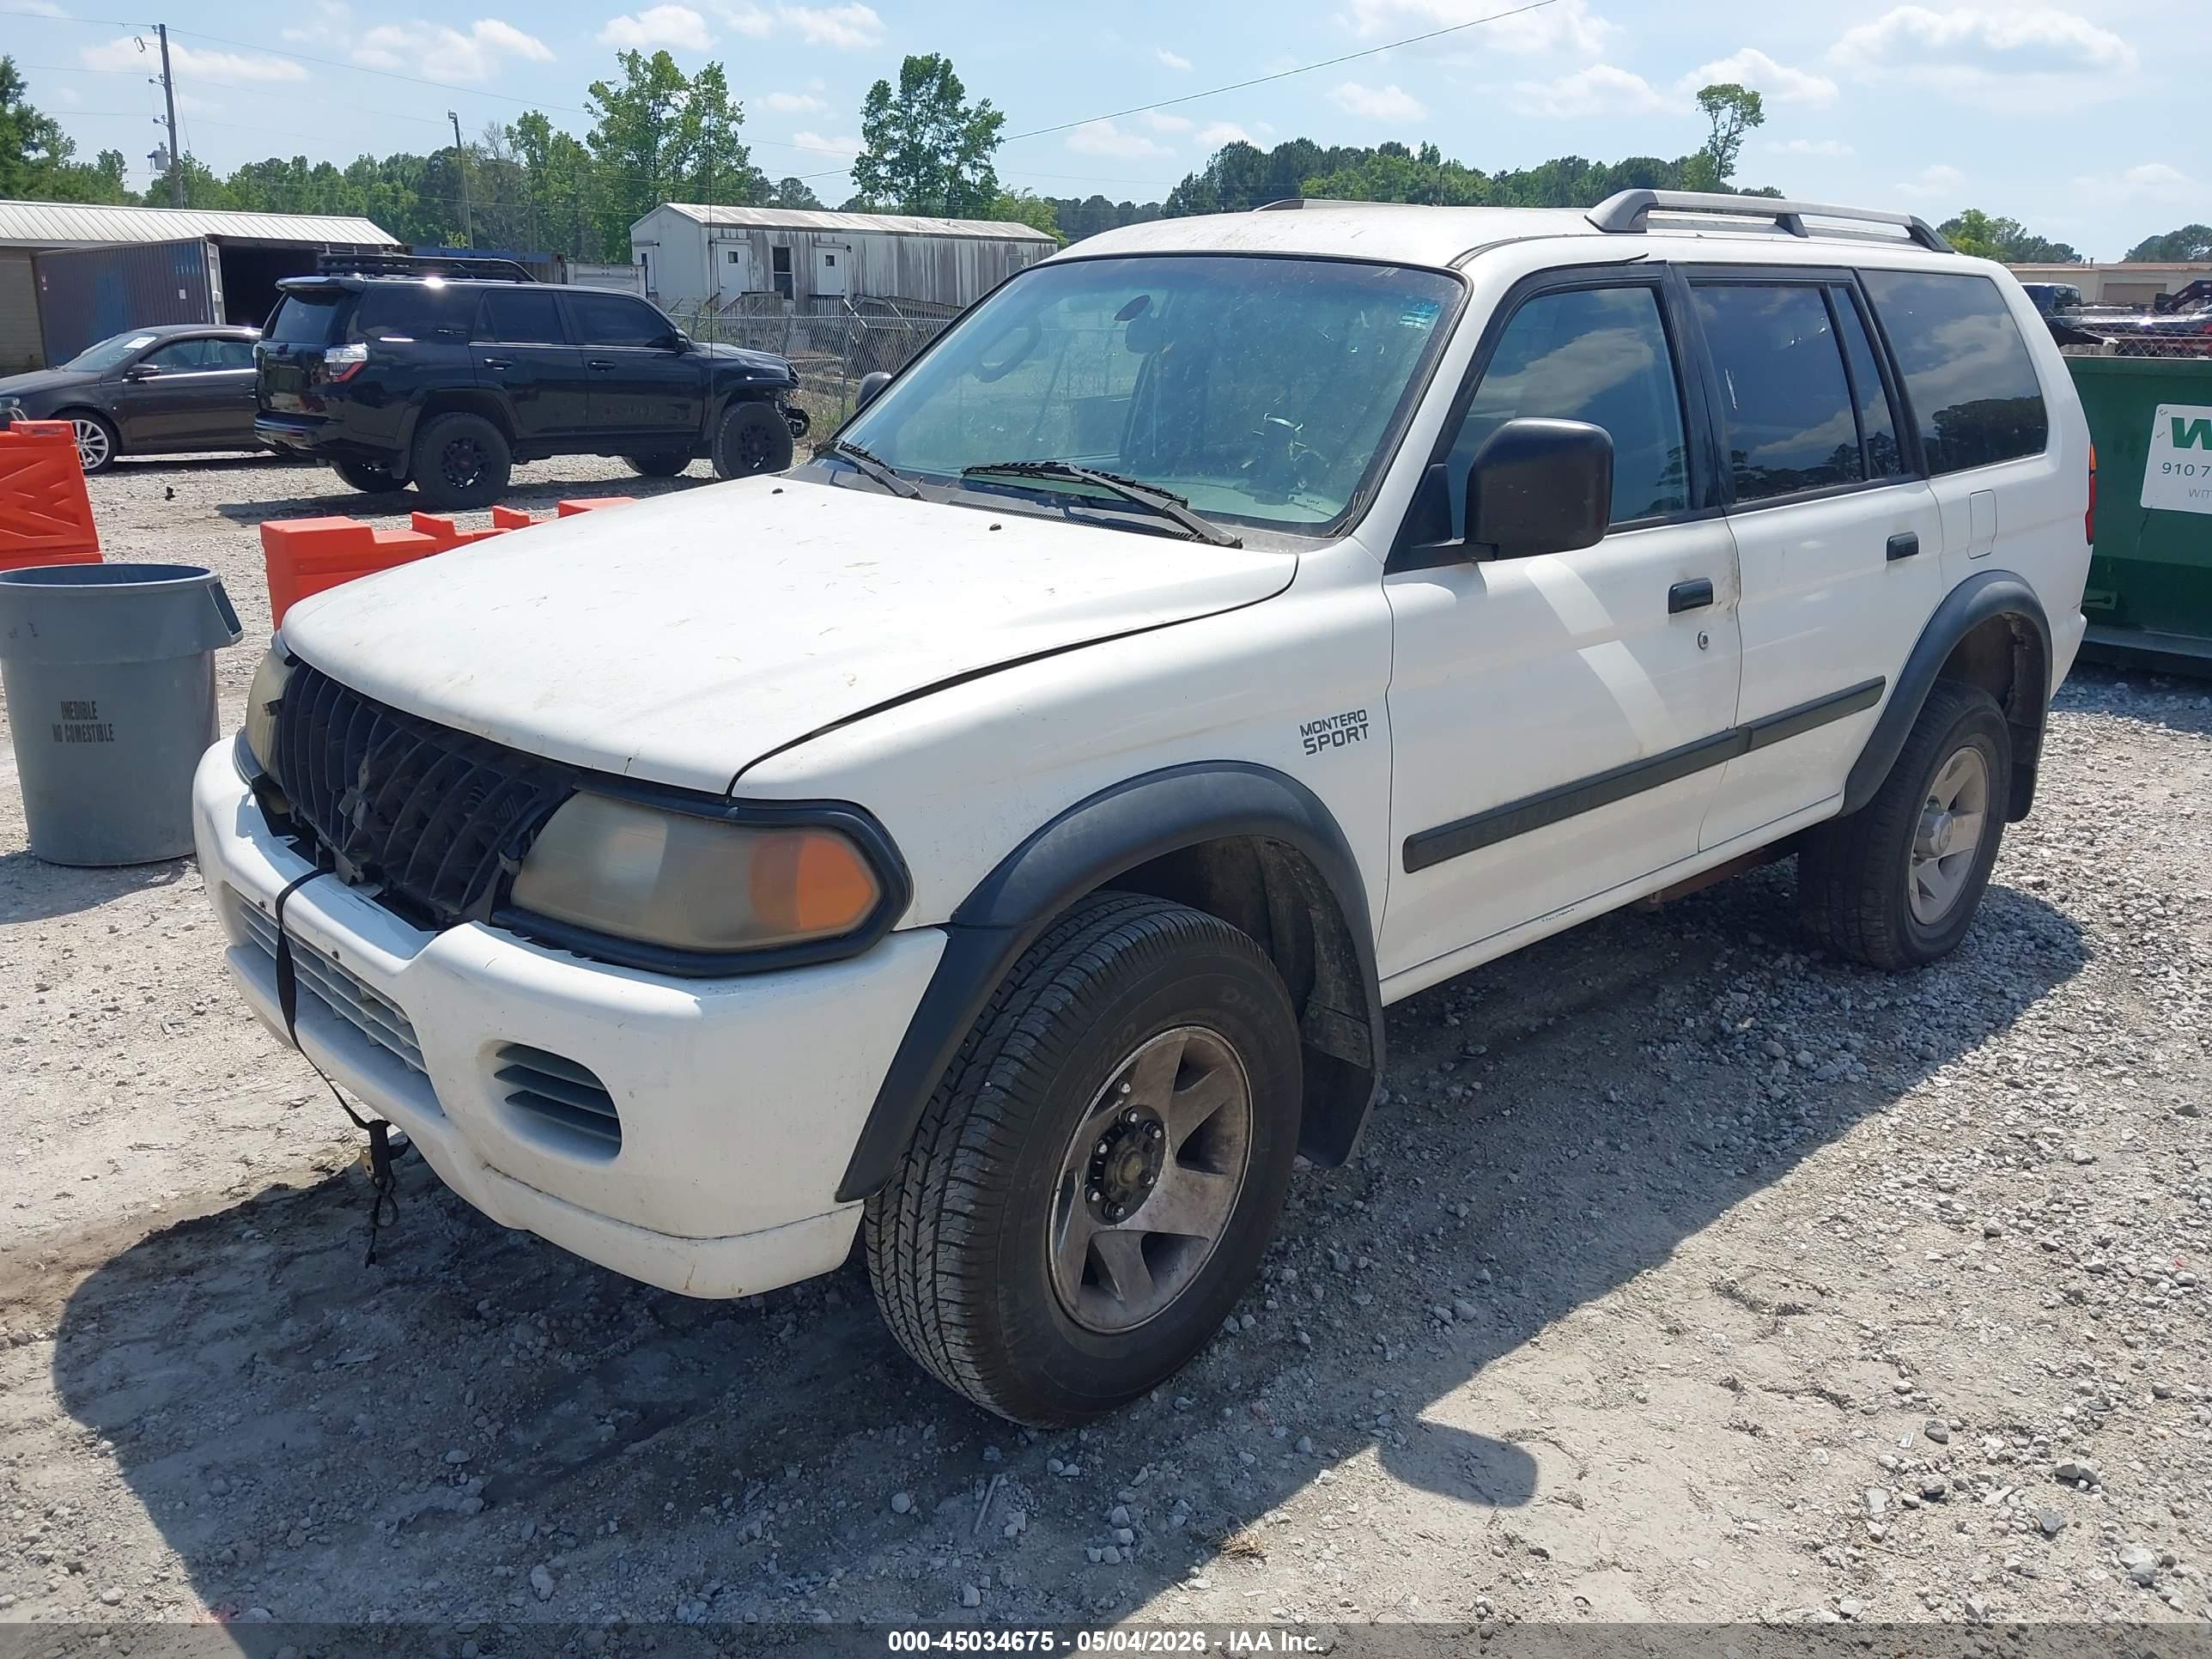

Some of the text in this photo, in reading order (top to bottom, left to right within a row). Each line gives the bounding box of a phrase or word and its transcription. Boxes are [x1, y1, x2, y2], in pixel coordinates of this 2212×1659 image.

[2162, 462, 2195, 477] 910
[64, 723, 115, 743] COMESTIBLE
[1299, 708, 1367, 738] MONTERO
[1303, 722, 1369, 756] SPORT
